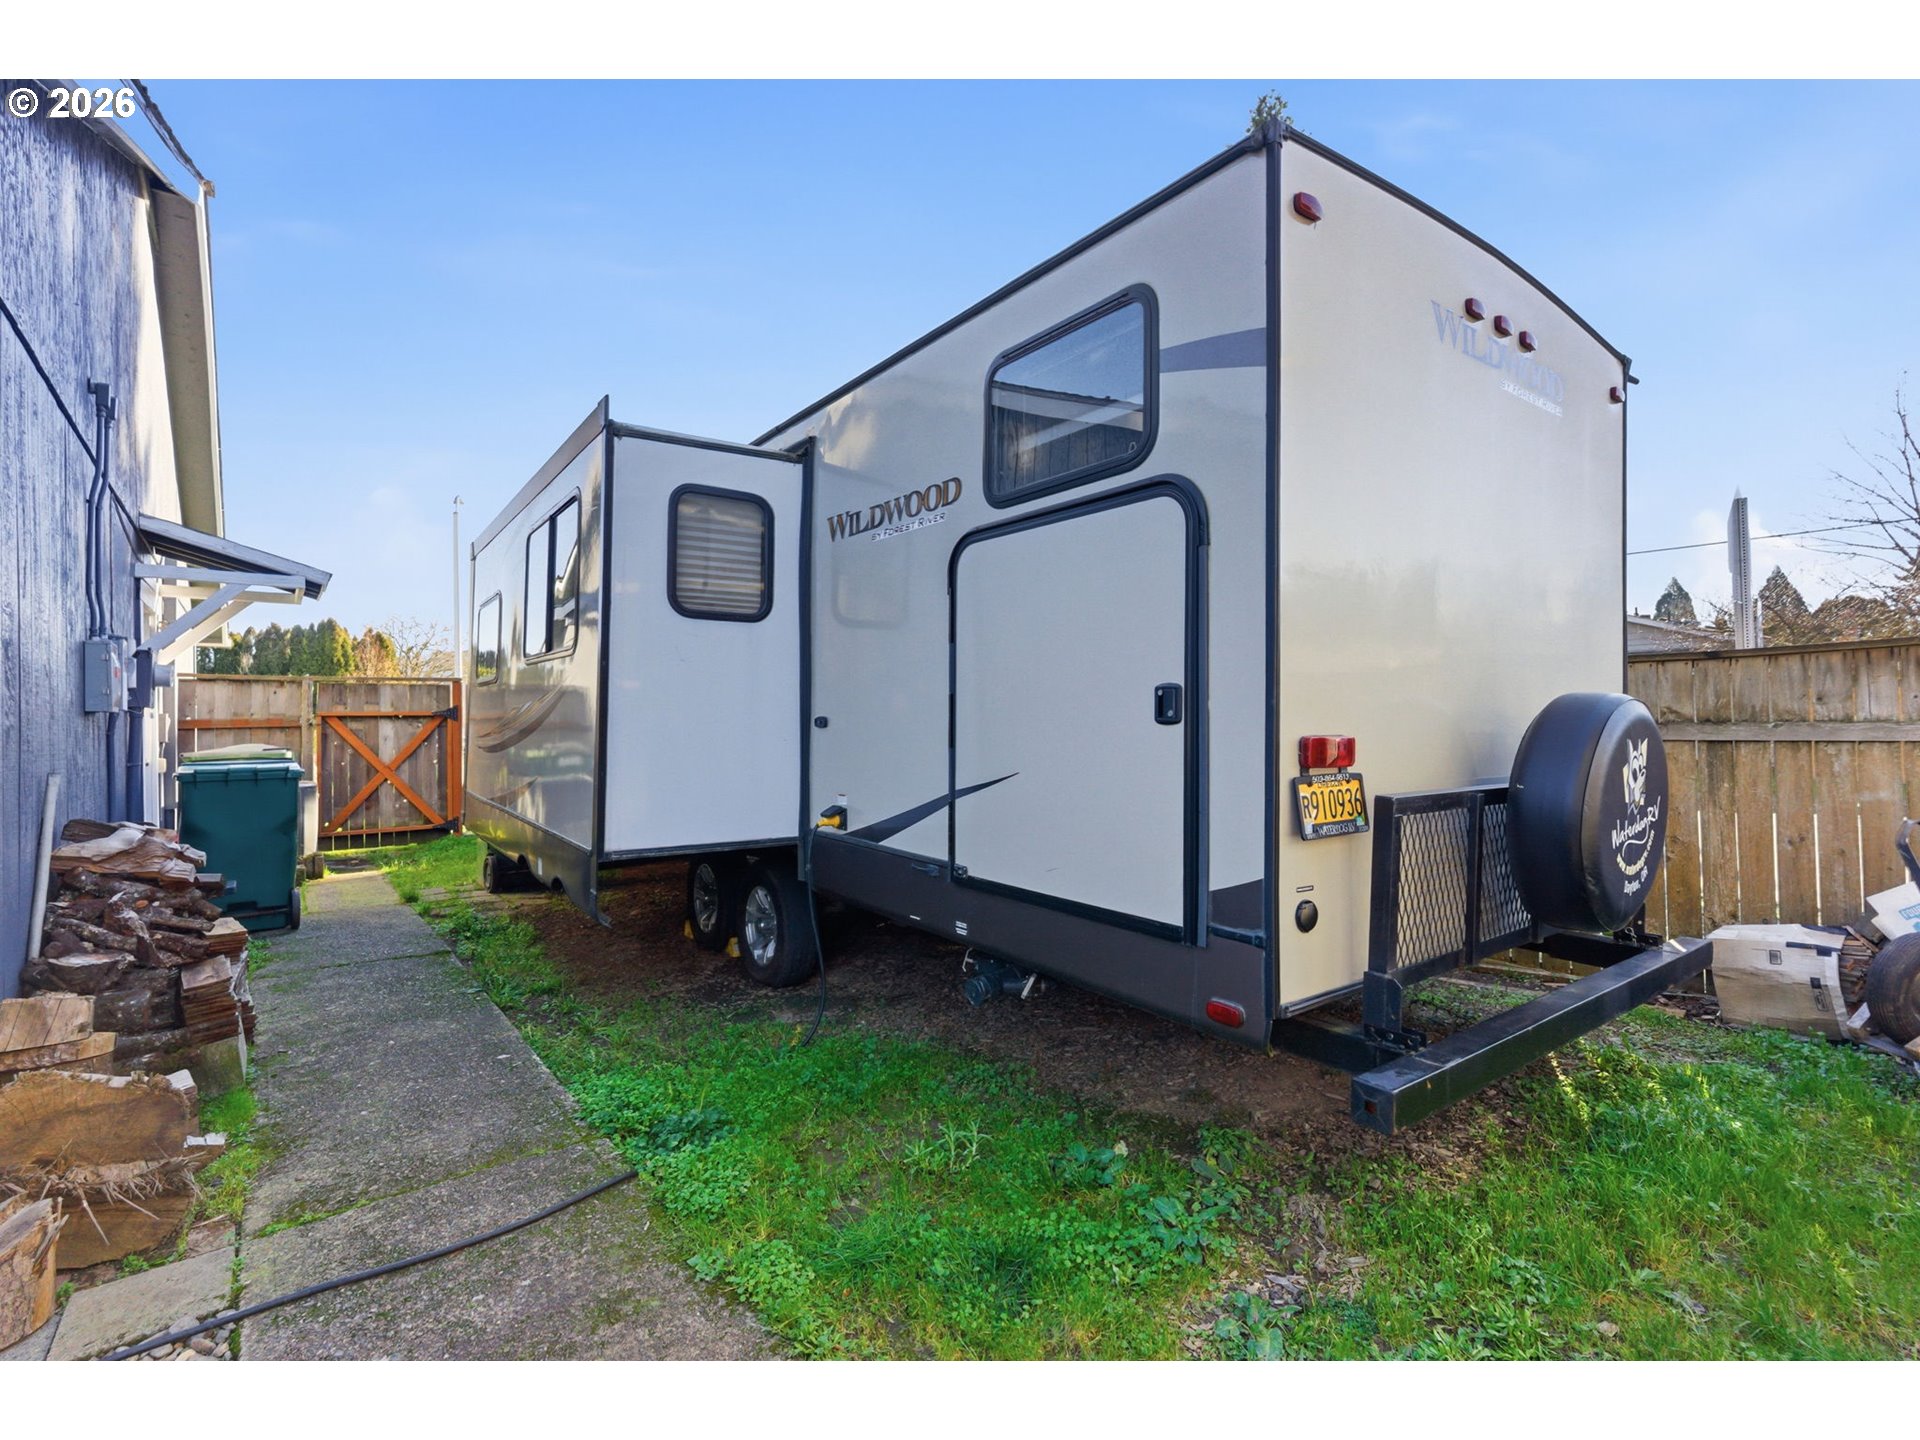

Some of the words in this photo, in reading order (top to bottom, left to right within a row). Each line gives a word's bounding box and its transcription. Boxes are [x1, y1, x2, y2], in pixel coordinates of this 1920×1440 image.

[827, 477, 962, 542] WILDWOOD
[884, 521, 916, 537] FOREST
[917, 513, 946, 528] RIVER
[1301, 788, 1362, 820] R910936
